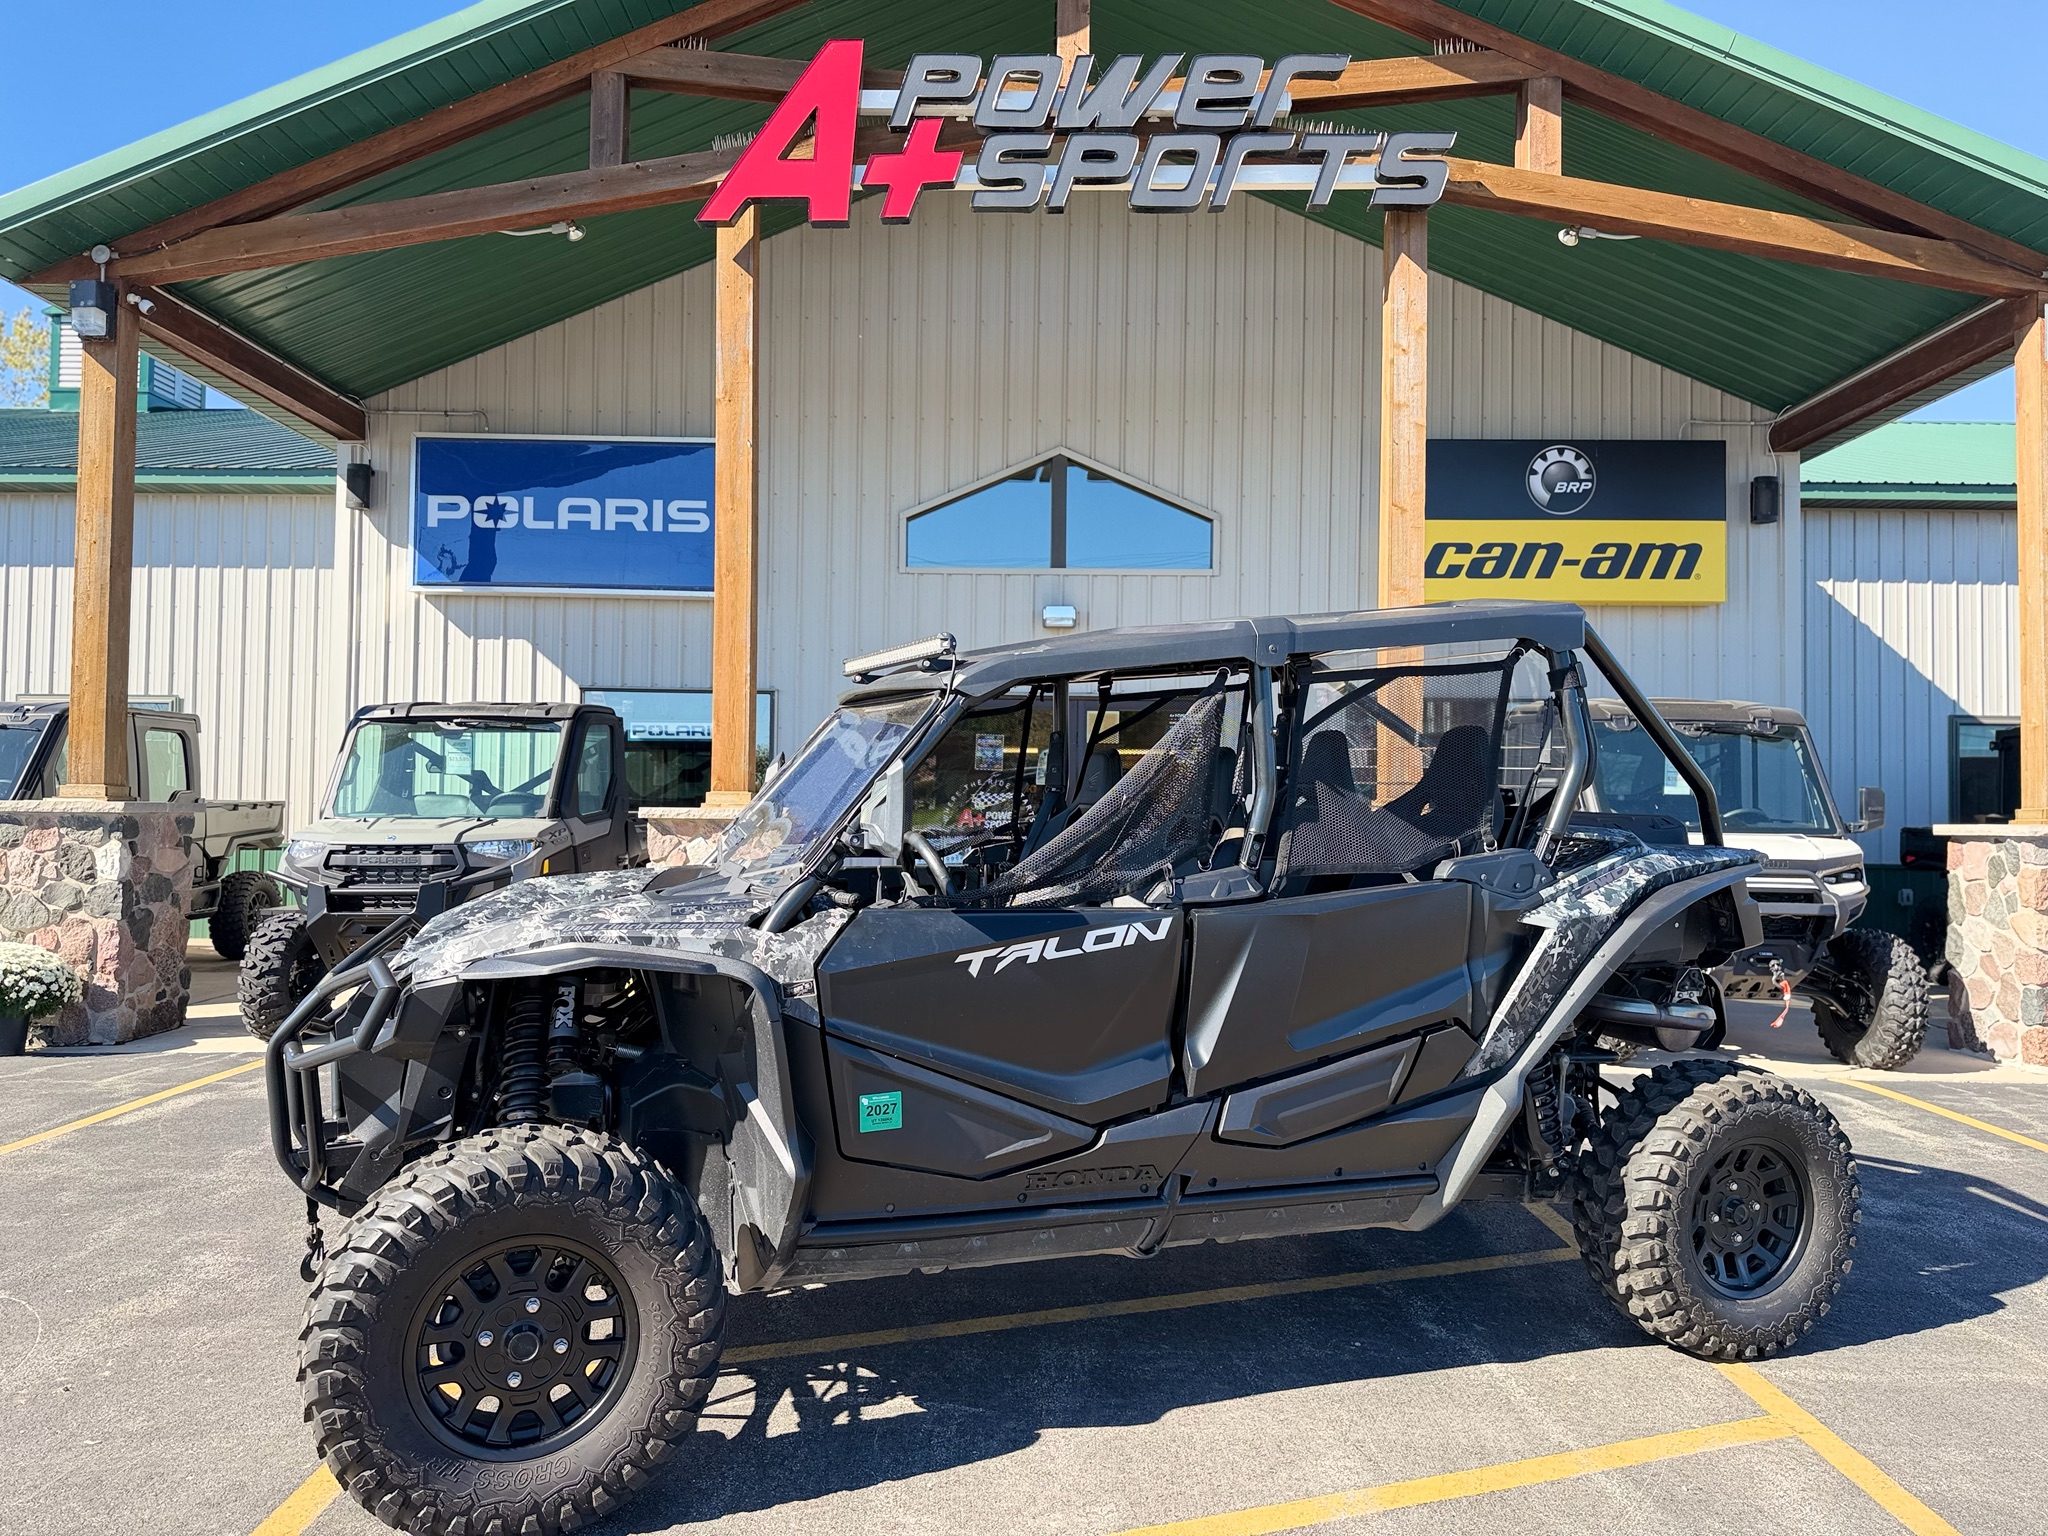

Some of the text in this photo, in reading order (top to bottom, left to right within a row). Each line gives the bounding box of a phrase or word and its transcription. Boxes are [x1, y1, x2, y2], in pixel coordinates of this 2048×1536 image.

[695, 38, 965, 227] A+
[1554, 481, 1592, 493] BRP
[426, 494, 711, 533] POLARIS
[1424, 542, 1703, 580] can-am
[631, 724, 713, 737] POLARI
[985, 811, 1013, 821] POWE
[549, 828, 567, 840] XP
[360, 856, 420, 865] POLARIS
[671, 904, 699, 915] FOX
[600, 922, 646, 931] Clutch
[648, 921, 742, 930] Transmission
[954, 916, 1173, 978] TALON
[554, 985, 577, 1029] FOX
[866, 1103, 898, 1117] 2027
[1025, 1164, 1164, 1192] HONDA
[1815, 1176, 1836, 1242] CROSS
[472, 1455, 572, 1491] CROSS
